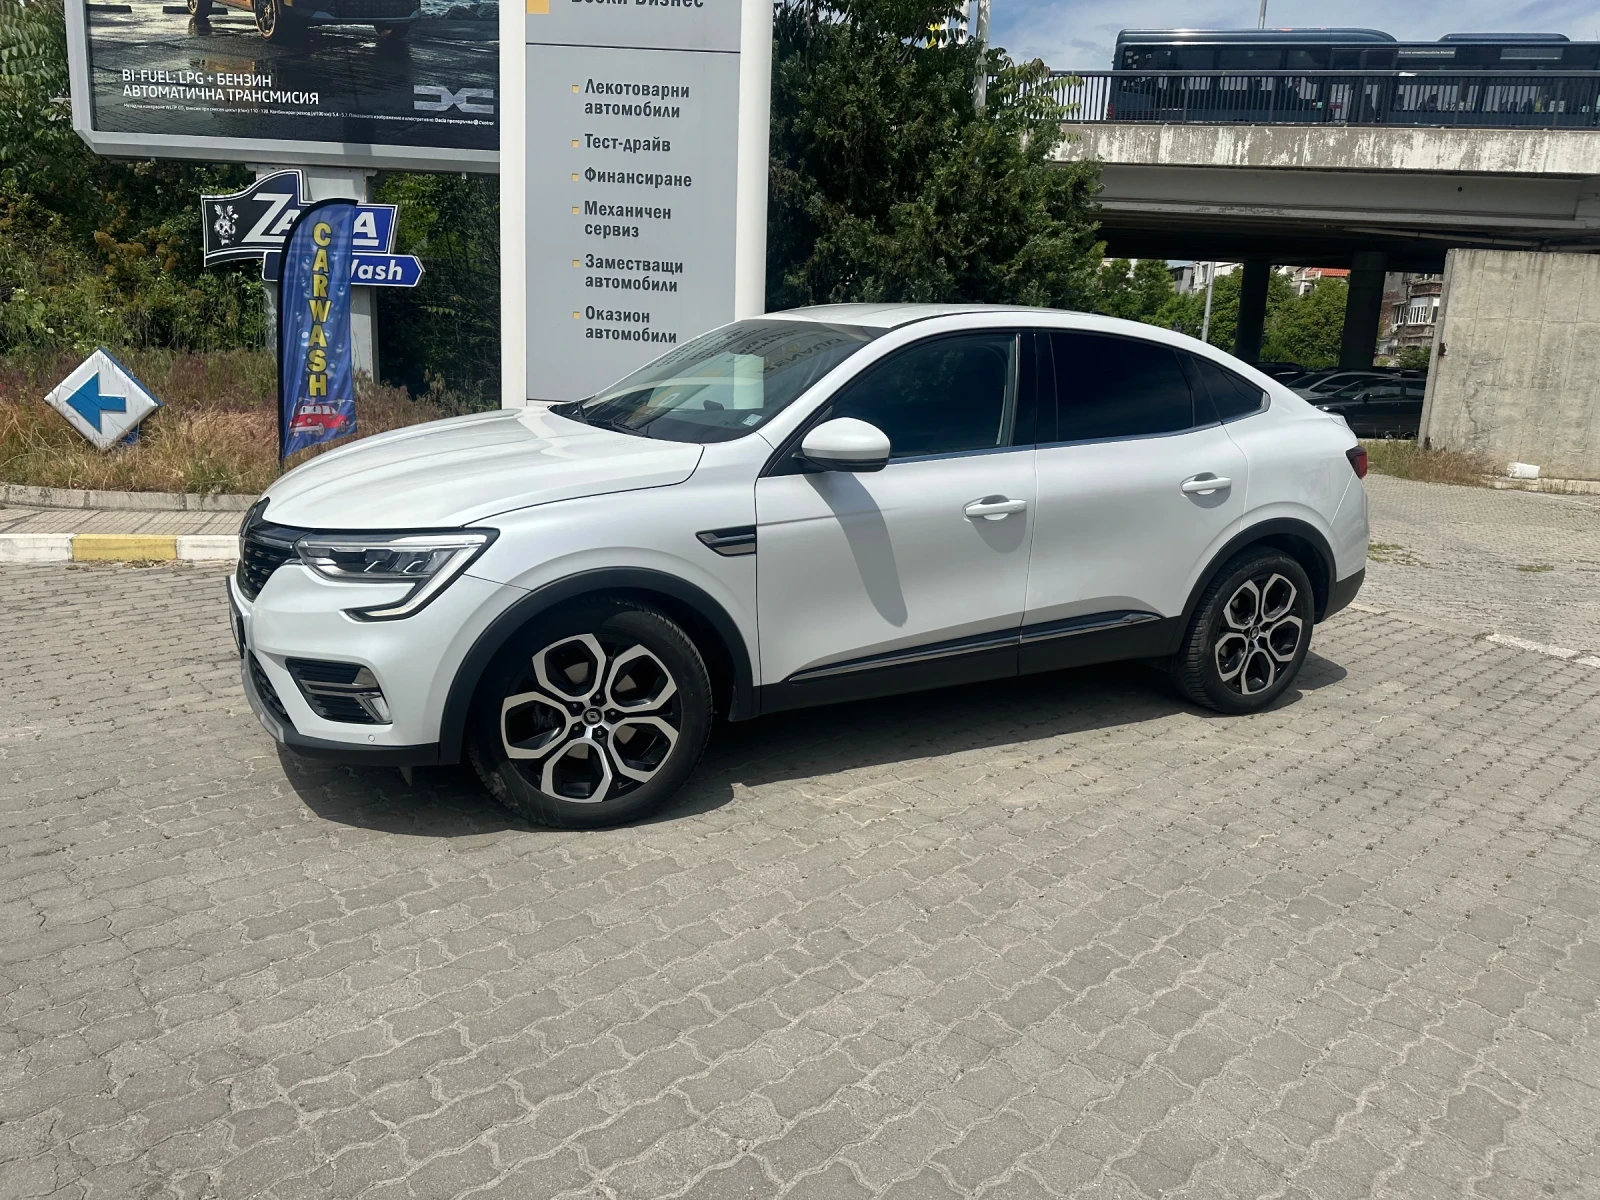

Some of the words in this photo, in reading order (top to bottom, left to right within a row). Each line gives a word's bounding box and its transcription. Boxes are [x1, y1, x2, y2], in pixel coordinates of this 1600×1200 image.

[122, 69, 176, 84] BI-FUEL:
[179, 72, 204, 84] LPG
[217, 73, 272, 87] БЕНЗИН
[122, 85, 225, 100] АВТОМАТИЧНА
[227, 89, 319, 105] ТРАНСМИСИЯ
[585, 79, 690, 100] Лекотоварни
[584, 101, 680, 118] автомобили
[584, 133, 671, 154] Тест-драйв
[584, 167, 692, 188] Финансиране
[242, 193, 378, 242] ZAA
[584, 201, 671, 219] Механичен
[584, 223, 639, 239] сервиз
[585, 254, 683, 275] Заместващи
[586, 276, 677, 292] автомобили
[585, 305, 650, 323] Оказион
[586, 327, 677, 343] автомобили
